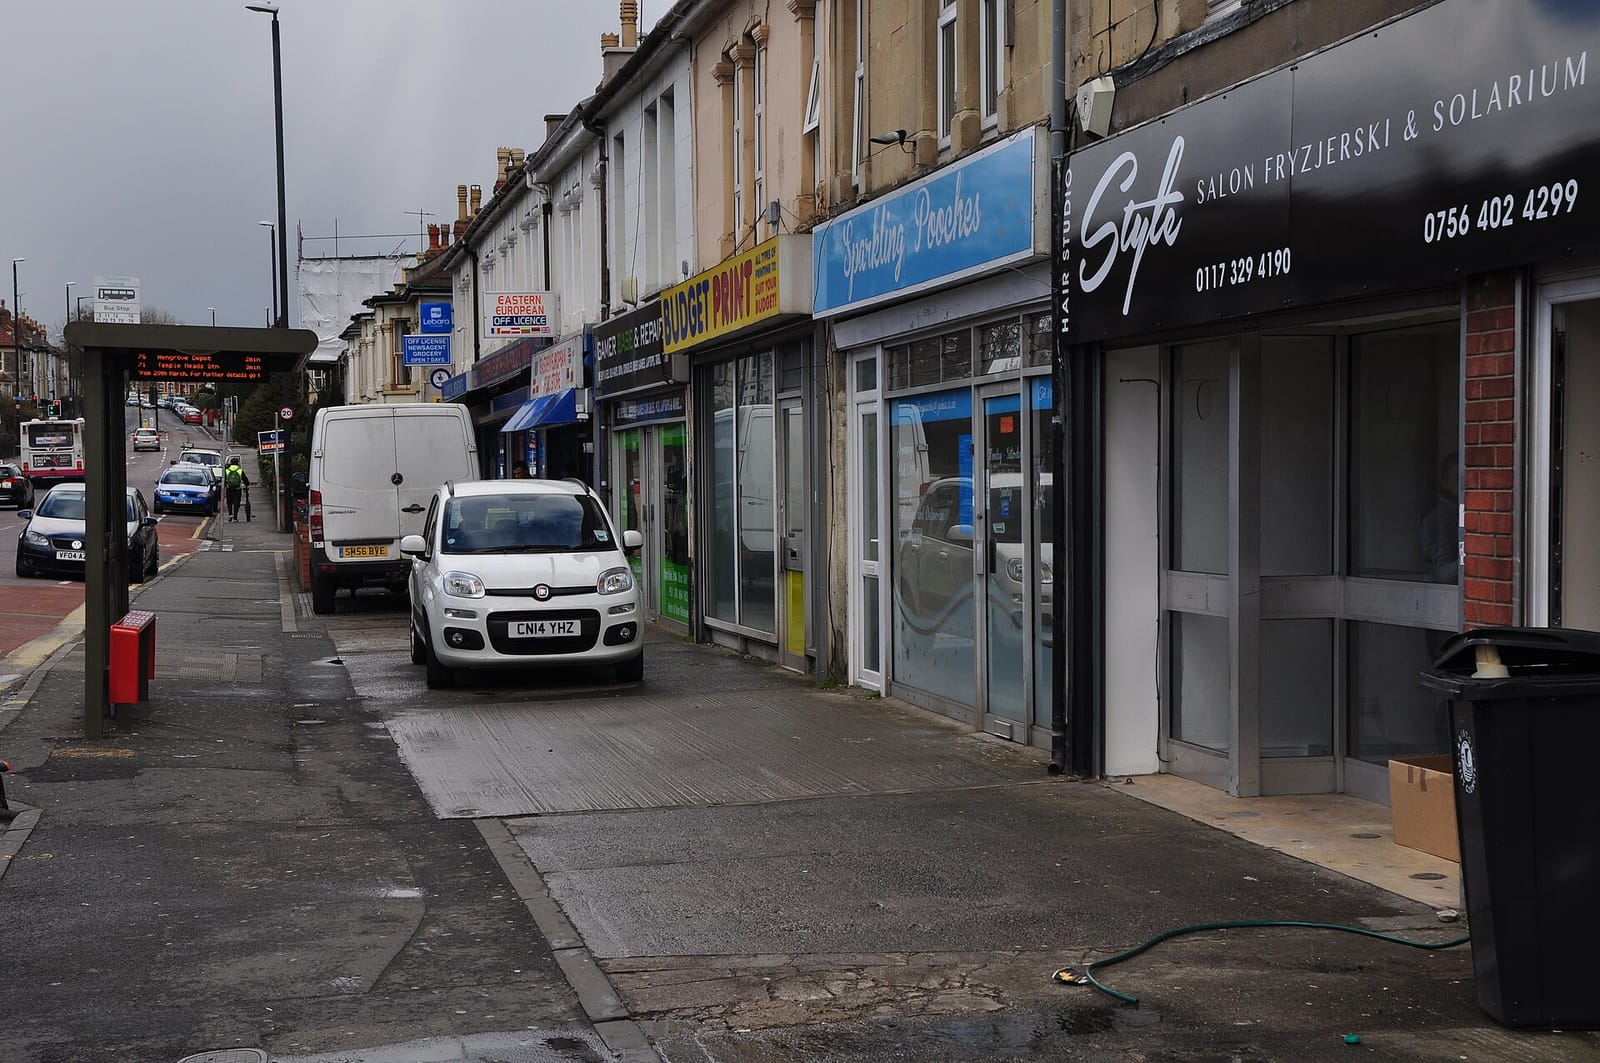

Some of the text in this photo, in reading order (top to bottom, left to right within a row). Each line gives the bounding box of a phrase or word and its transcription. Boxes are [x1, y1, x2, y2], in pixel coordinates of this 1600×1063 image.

[1196, 51, 1587, 205] SALON FRYZJERSKI & SOLARIUM
[1078, 135, 1185, 316] Style
[1424, 178, 1578, 243] 0756 402 4299
[842, 170, 982, 301] Sparkling Pooches
[1061, 168, 1073, 332] HAIR STUDIO
[1196, 247, 1291, 293] 0117 329 4190
[423, 318, 450, 326] Lebara
[493, 316, 546, 326] OFF LICENCE
[495, 305, 545, 315] EUROPEAN
[497, 295, 542, 305] EASTERN
[663, 259, 753, 346] BUDGET PRINT
[597, 335, 617, 361] GAMER
[517, 621, 574, 635] CN14 YHZ
